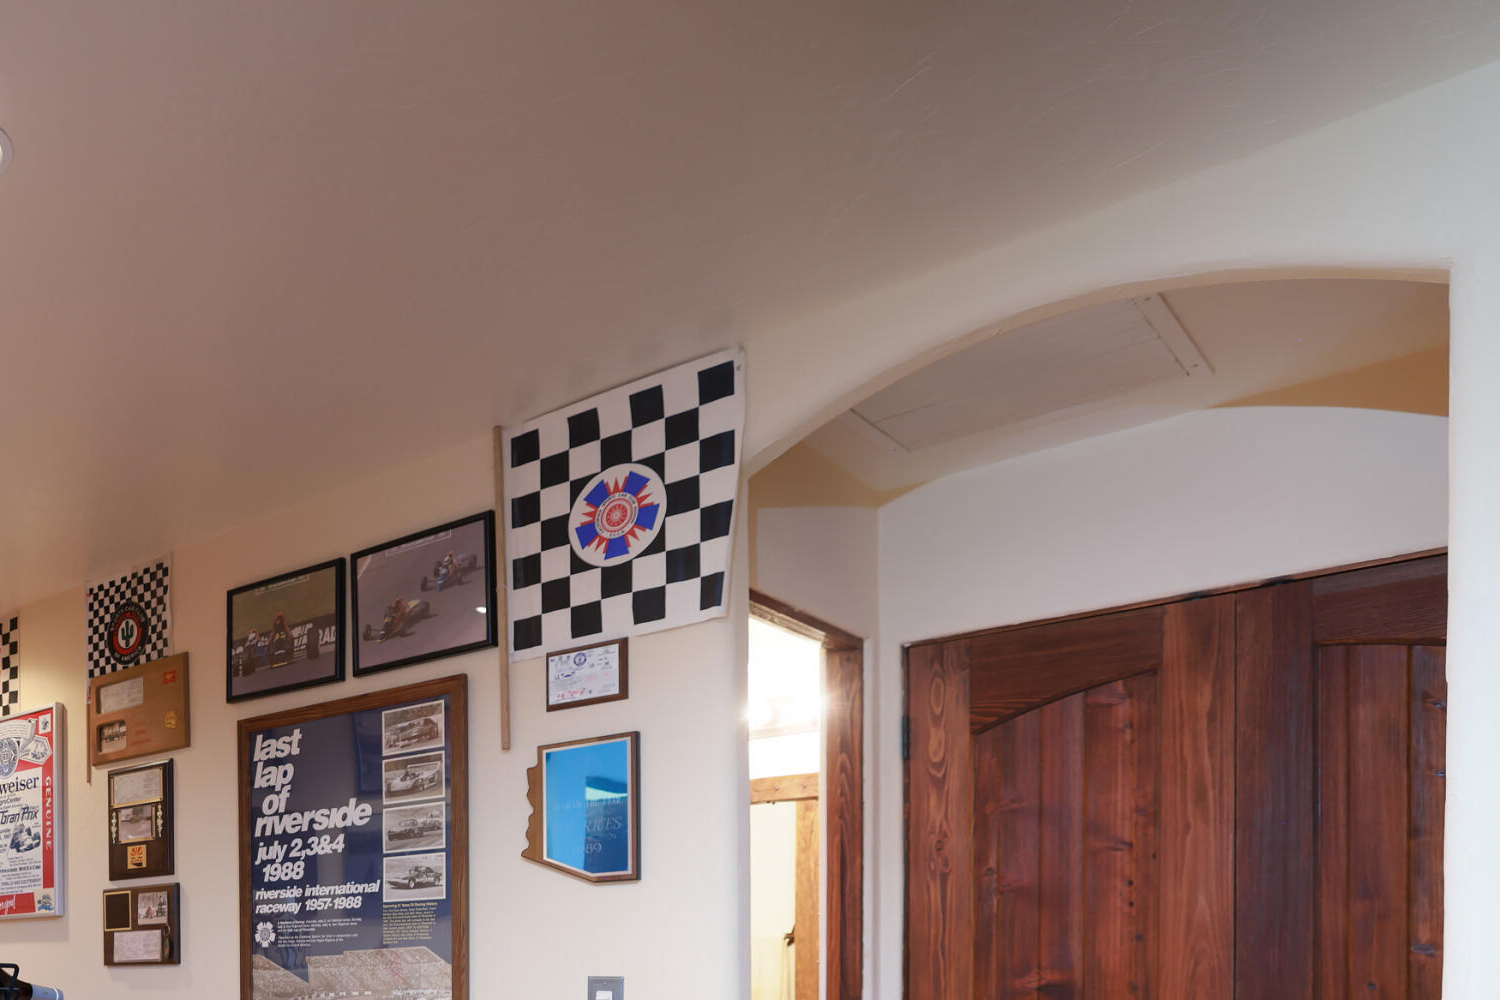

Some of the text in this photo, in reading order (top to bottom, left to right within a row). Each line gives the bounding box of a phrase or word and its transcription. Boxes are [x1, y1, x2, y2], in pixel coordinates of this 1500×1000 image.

[254, 728, 302, 762] last
[254, 761, 294, 791] lap
[21, 806, 39, 821] Prix
[262, 785, 291, 815] of
[254, 798, 372, 837] riverside
[255, 834, 345, 865] july 2,3&4
[262, 860, 305, 882] 1988
[256, 880, 380, 900] riverside international
[256, 896, 362, 914] raceway 1957-1988
